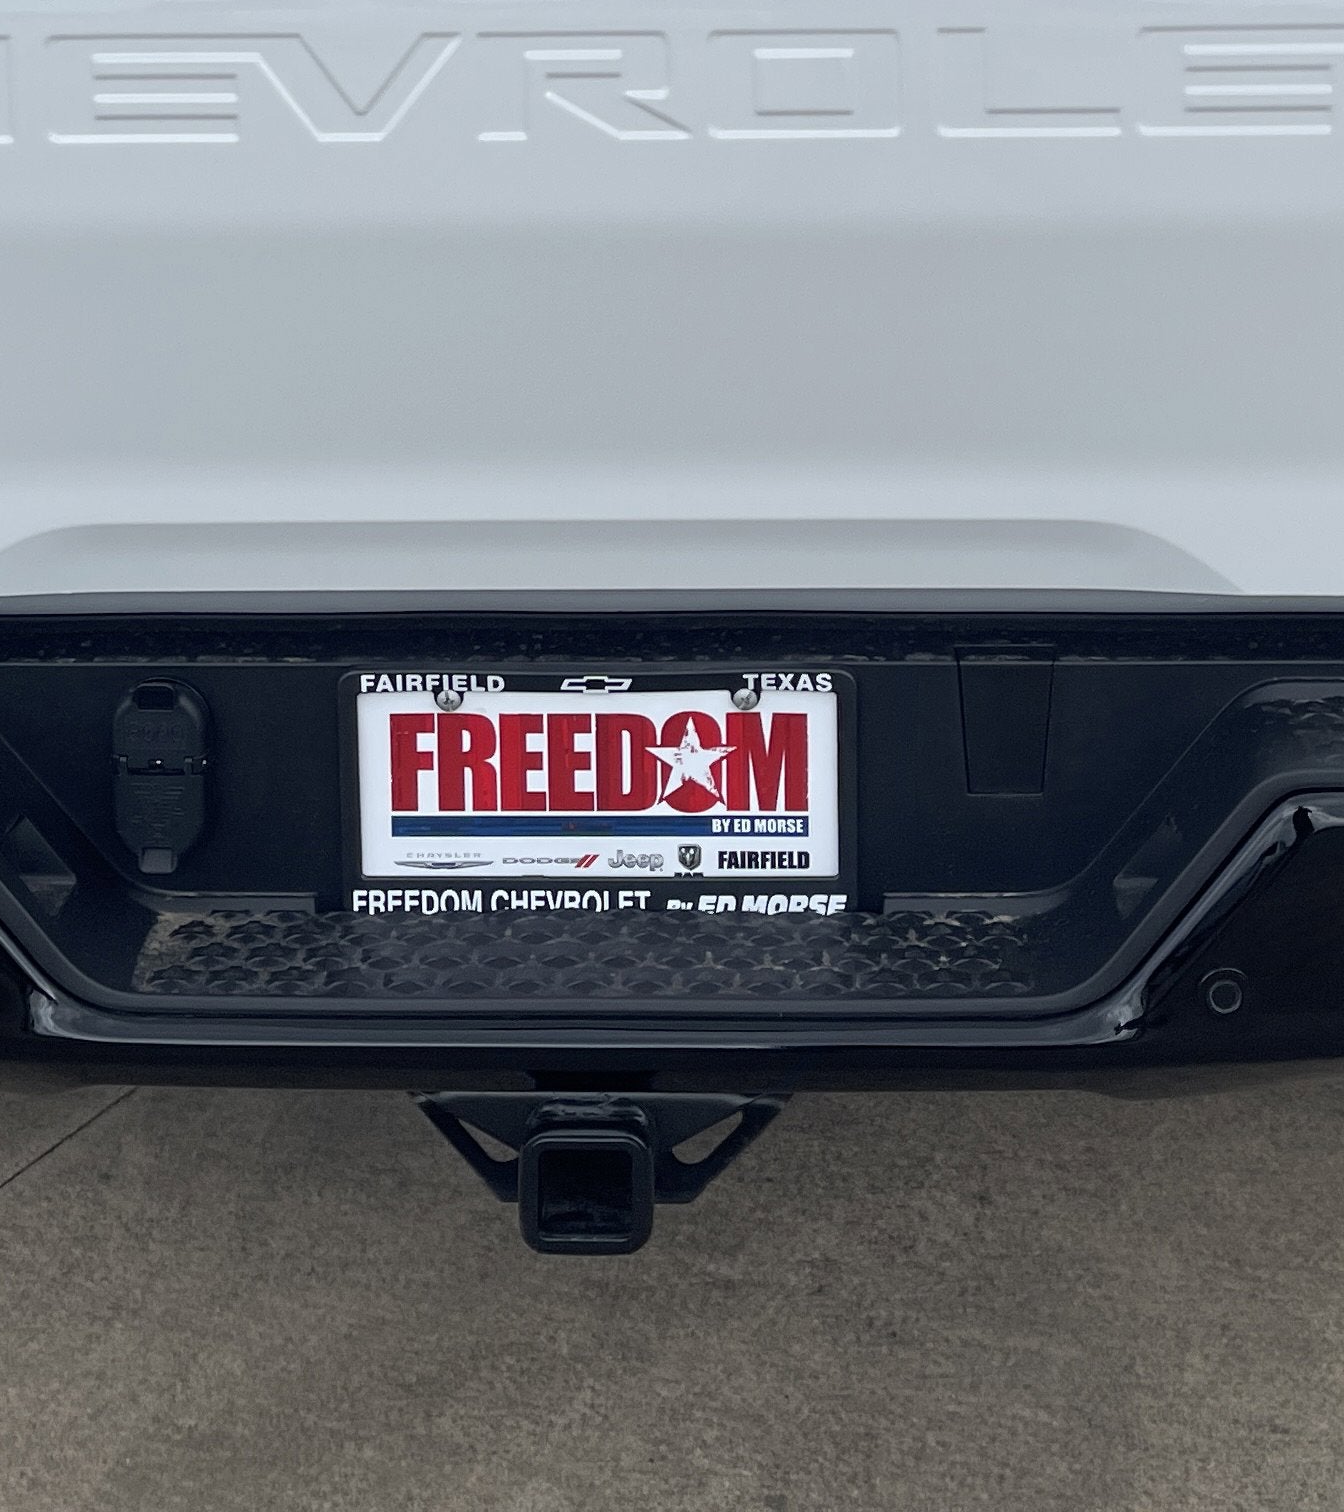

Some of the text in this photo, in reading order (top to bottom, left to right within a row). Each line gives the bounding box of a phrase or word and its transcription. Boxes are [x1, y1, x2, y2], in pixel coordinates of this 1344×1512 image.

[360, 674, 505, 693] FAIRFIELD
[742, 673, 833, 692] TEXAS
[389, 710, 810, 813] FREEDOM
[711, 819, 804, 833] BY ED MORSE
[607, 849, 665, 872] Jeep
[718, 850, 810, 870] FAIRFIELD
